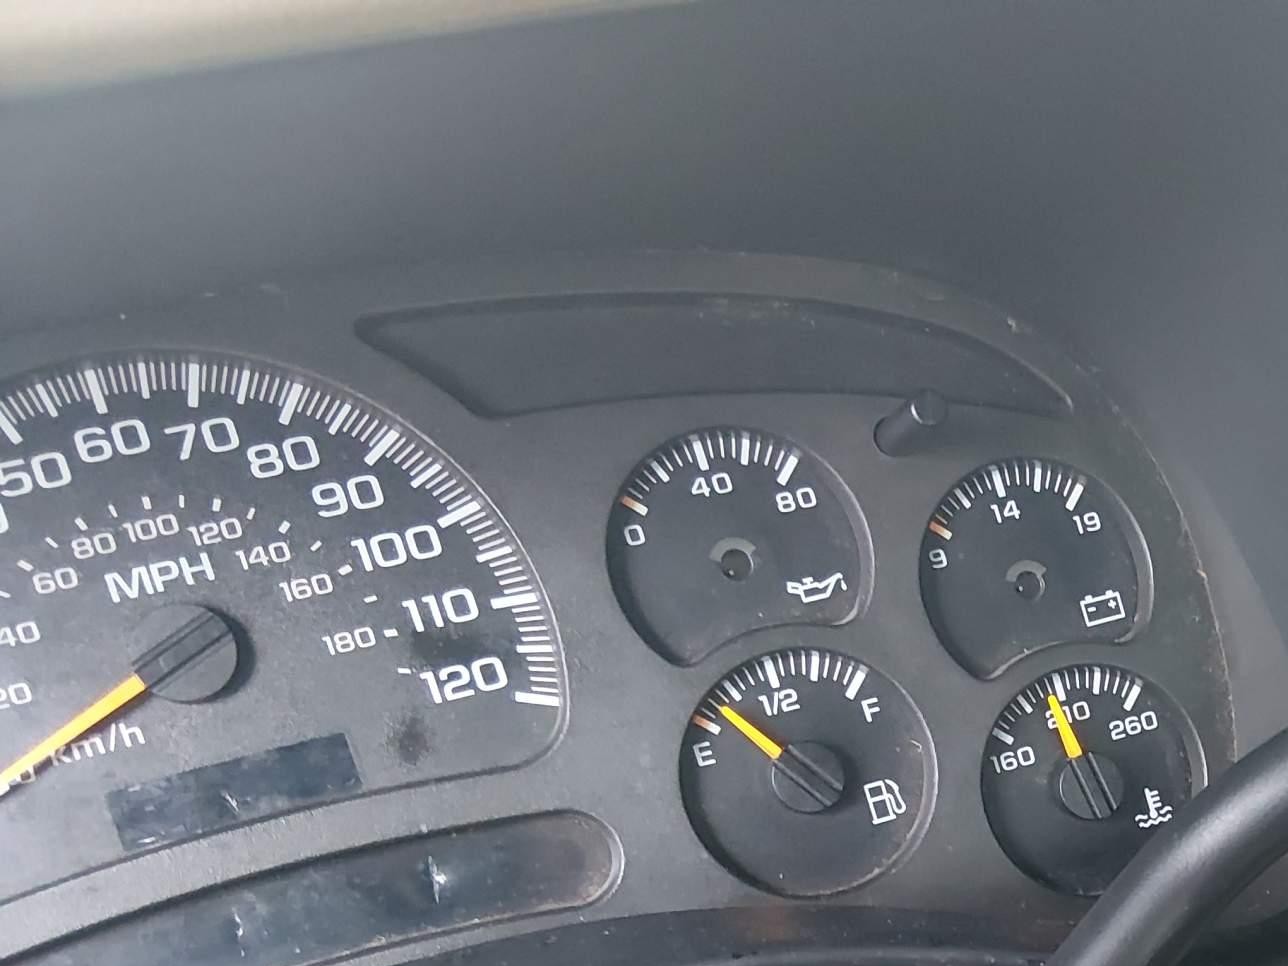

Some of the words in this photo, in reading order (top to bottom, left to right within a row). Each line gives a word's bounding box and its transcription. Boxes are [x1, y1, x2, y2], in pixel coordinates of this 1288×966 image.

[73, 419, 151, 463] 60
[163, 417, 240, 461] 70
[246, 435, 320, 479] 80
[0, 451, 72, 497] 50
[691, 472, 733, 497] 40
[311, 474, 384, 518] 90
[775, 487, 817, 513] 80
[990, 499, 1021, 524] 14
[1072, 511, 1101, 535] 19
[122, 513, 180, 543] 100
[186, 517, 243, 547] 120
[624, 524, 646, 546] 0
[71, 532, 117, 560] 80
[234, 541, 291, 571] 140
[350, 523, 444, 572] 100
[929, 548, 948, 569] 9
[32, 567, 78, 594] 60
[103, 552, 215, 603] MPH
[278, 573, 334, 603] 160
[401, 587, 479, 633] 110
[321, 626, 376, 656] 180
[419, 656, 508, 704] 120
[757, 688, 801, 717] 1/2
[860, 697, 881, 723] F
[1108, 710, 1158, 741] 260
[693, 741, 717, 767] E
[989, 745, 1037, 775] 160
